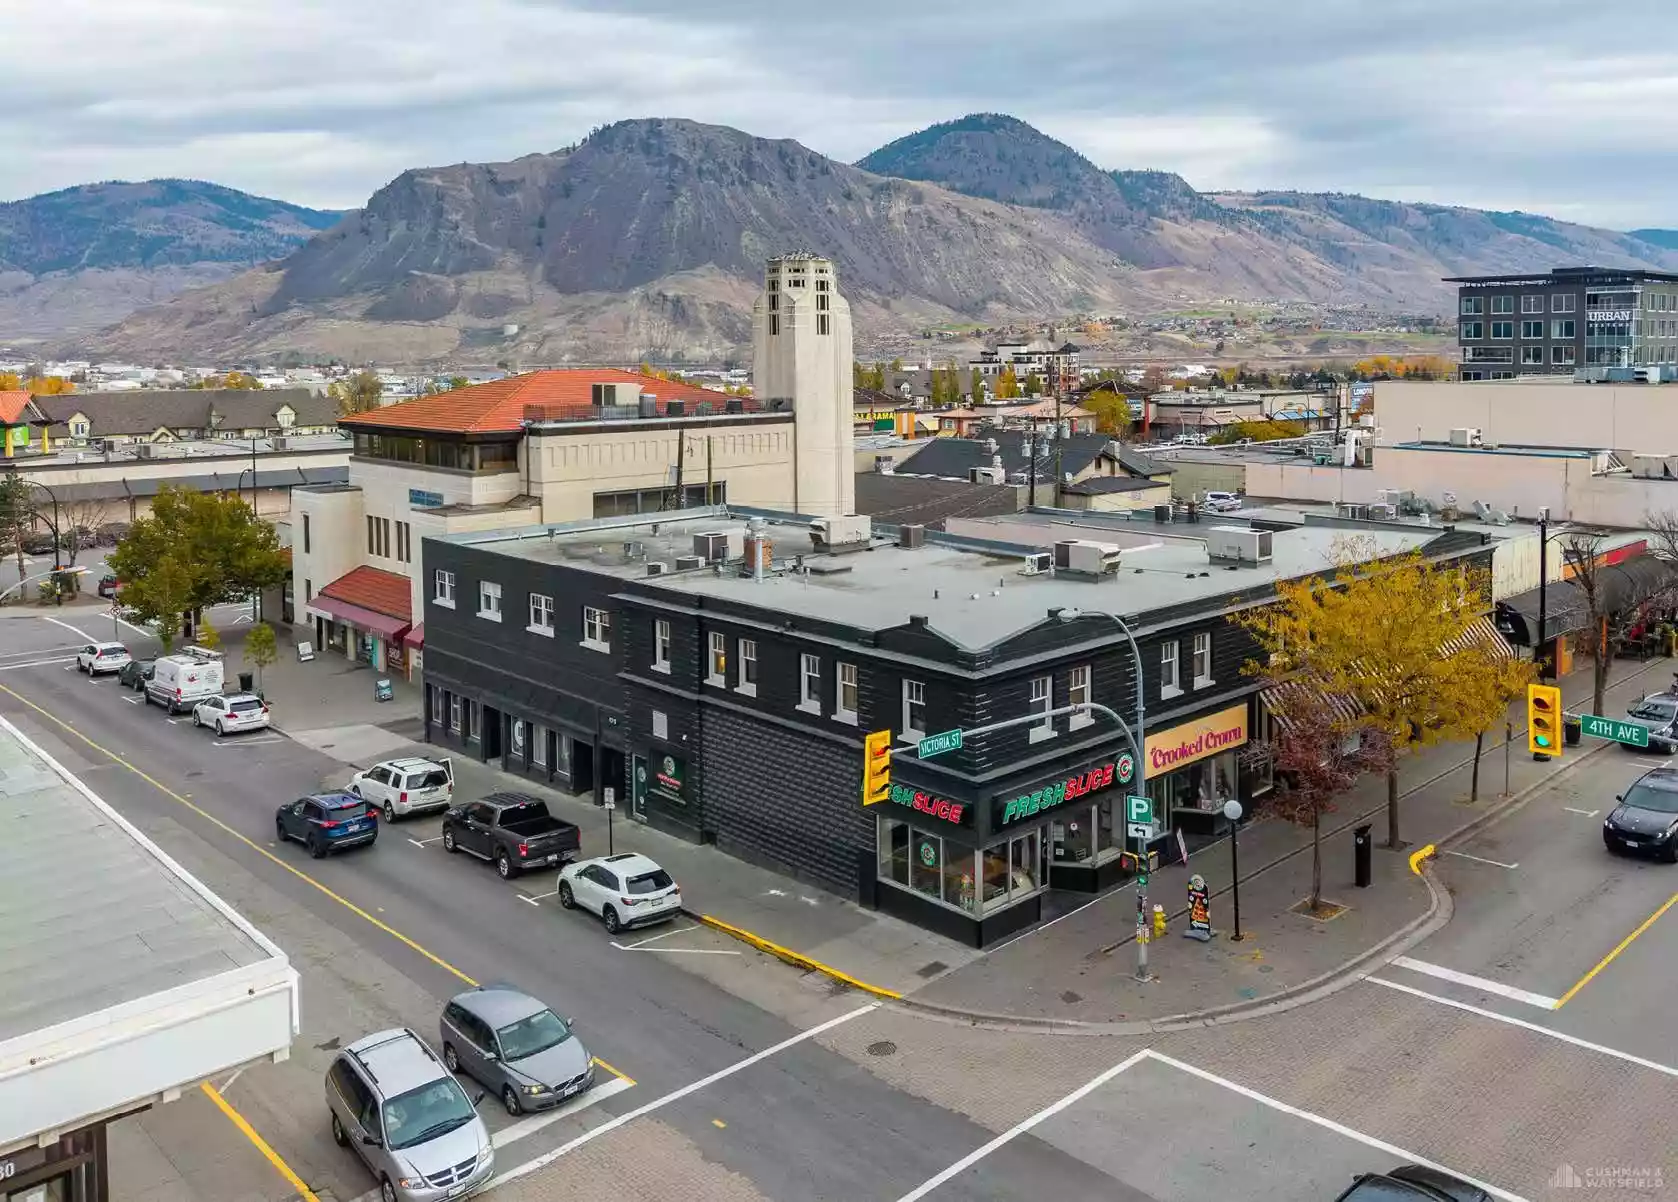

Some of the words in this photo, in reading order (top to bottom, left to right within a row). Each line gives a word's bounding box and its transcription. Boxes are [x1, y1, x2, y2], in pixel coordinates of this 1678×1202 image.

[1588, 311, 1630, 321] URBAN
[1589, 720, 1613, 736] 4TH
[1617, 725, 1640, 742] AVE
[921, 736, 950, 756] VICTORIA
[951, 733, 960, 747] ST
[1152, 736, 1203, 769] Crooked
[1205, 726, 1242, 750] Crown
[860, 782, 964, 824] SHSLICE
[1002, 763, 1115, 825] FRESHSLICE
[1131, 798, 1149, 820] P
